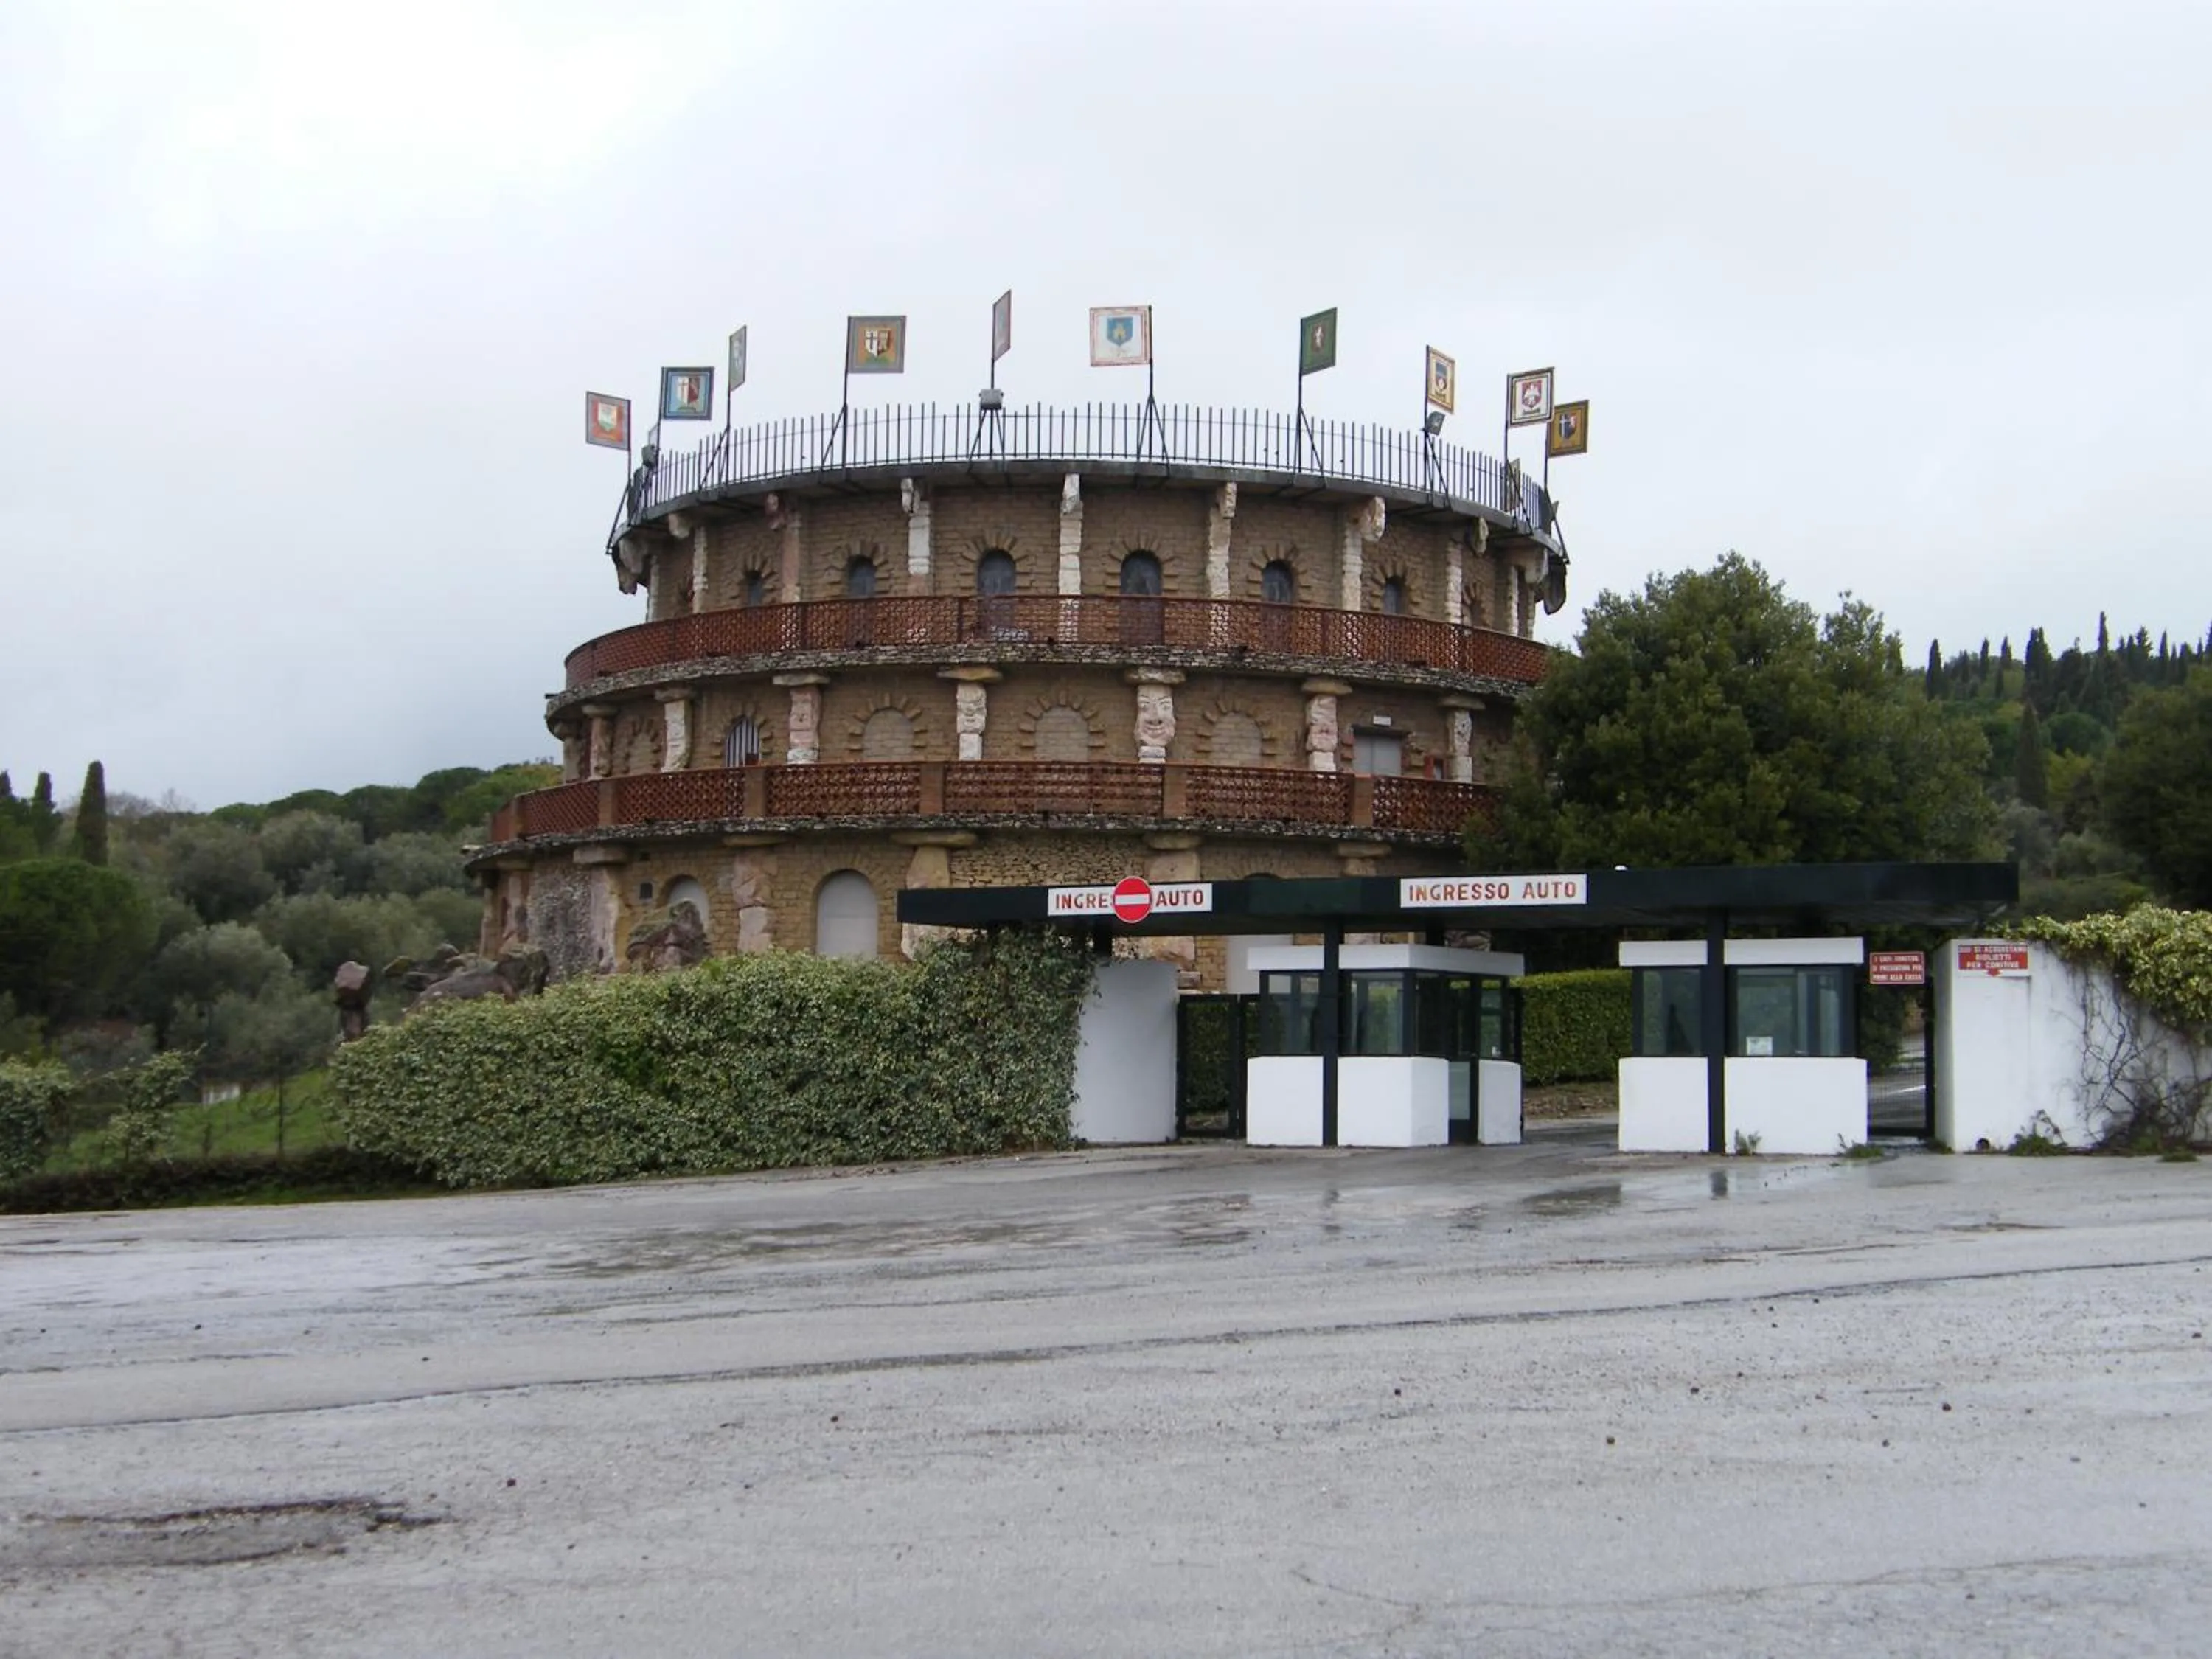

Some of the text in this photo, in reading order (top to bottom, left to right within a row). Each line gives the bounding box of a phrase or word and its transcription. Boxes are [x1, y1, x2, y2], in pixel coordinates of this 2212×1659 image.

[1055, 889, 1204, 909] INGRE AUTO
[1409, 881, 1576, 901] INGRESSO AUTO
